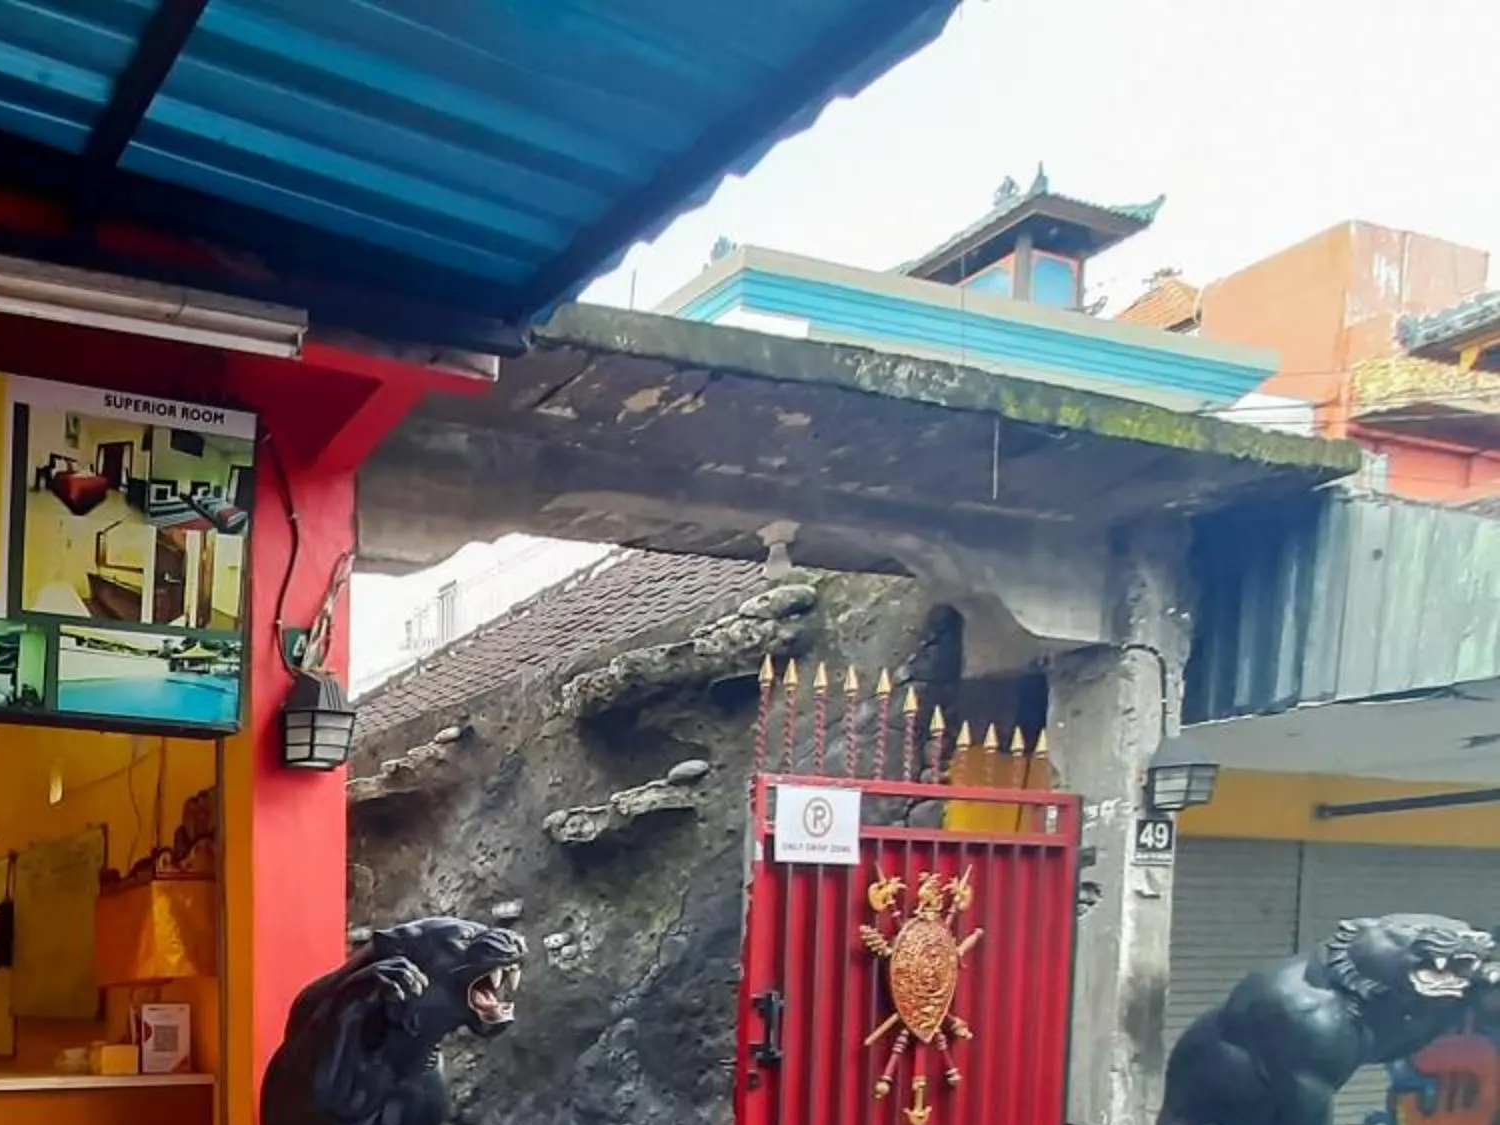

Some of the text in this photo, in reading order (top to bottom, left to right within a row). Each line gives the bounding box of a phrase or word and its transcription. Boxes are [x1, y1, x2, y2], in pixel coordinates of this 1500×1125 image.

[104, 393, 225, 425] SUPERIOR ROOM
[1139, 822, 1169, 849] 49
